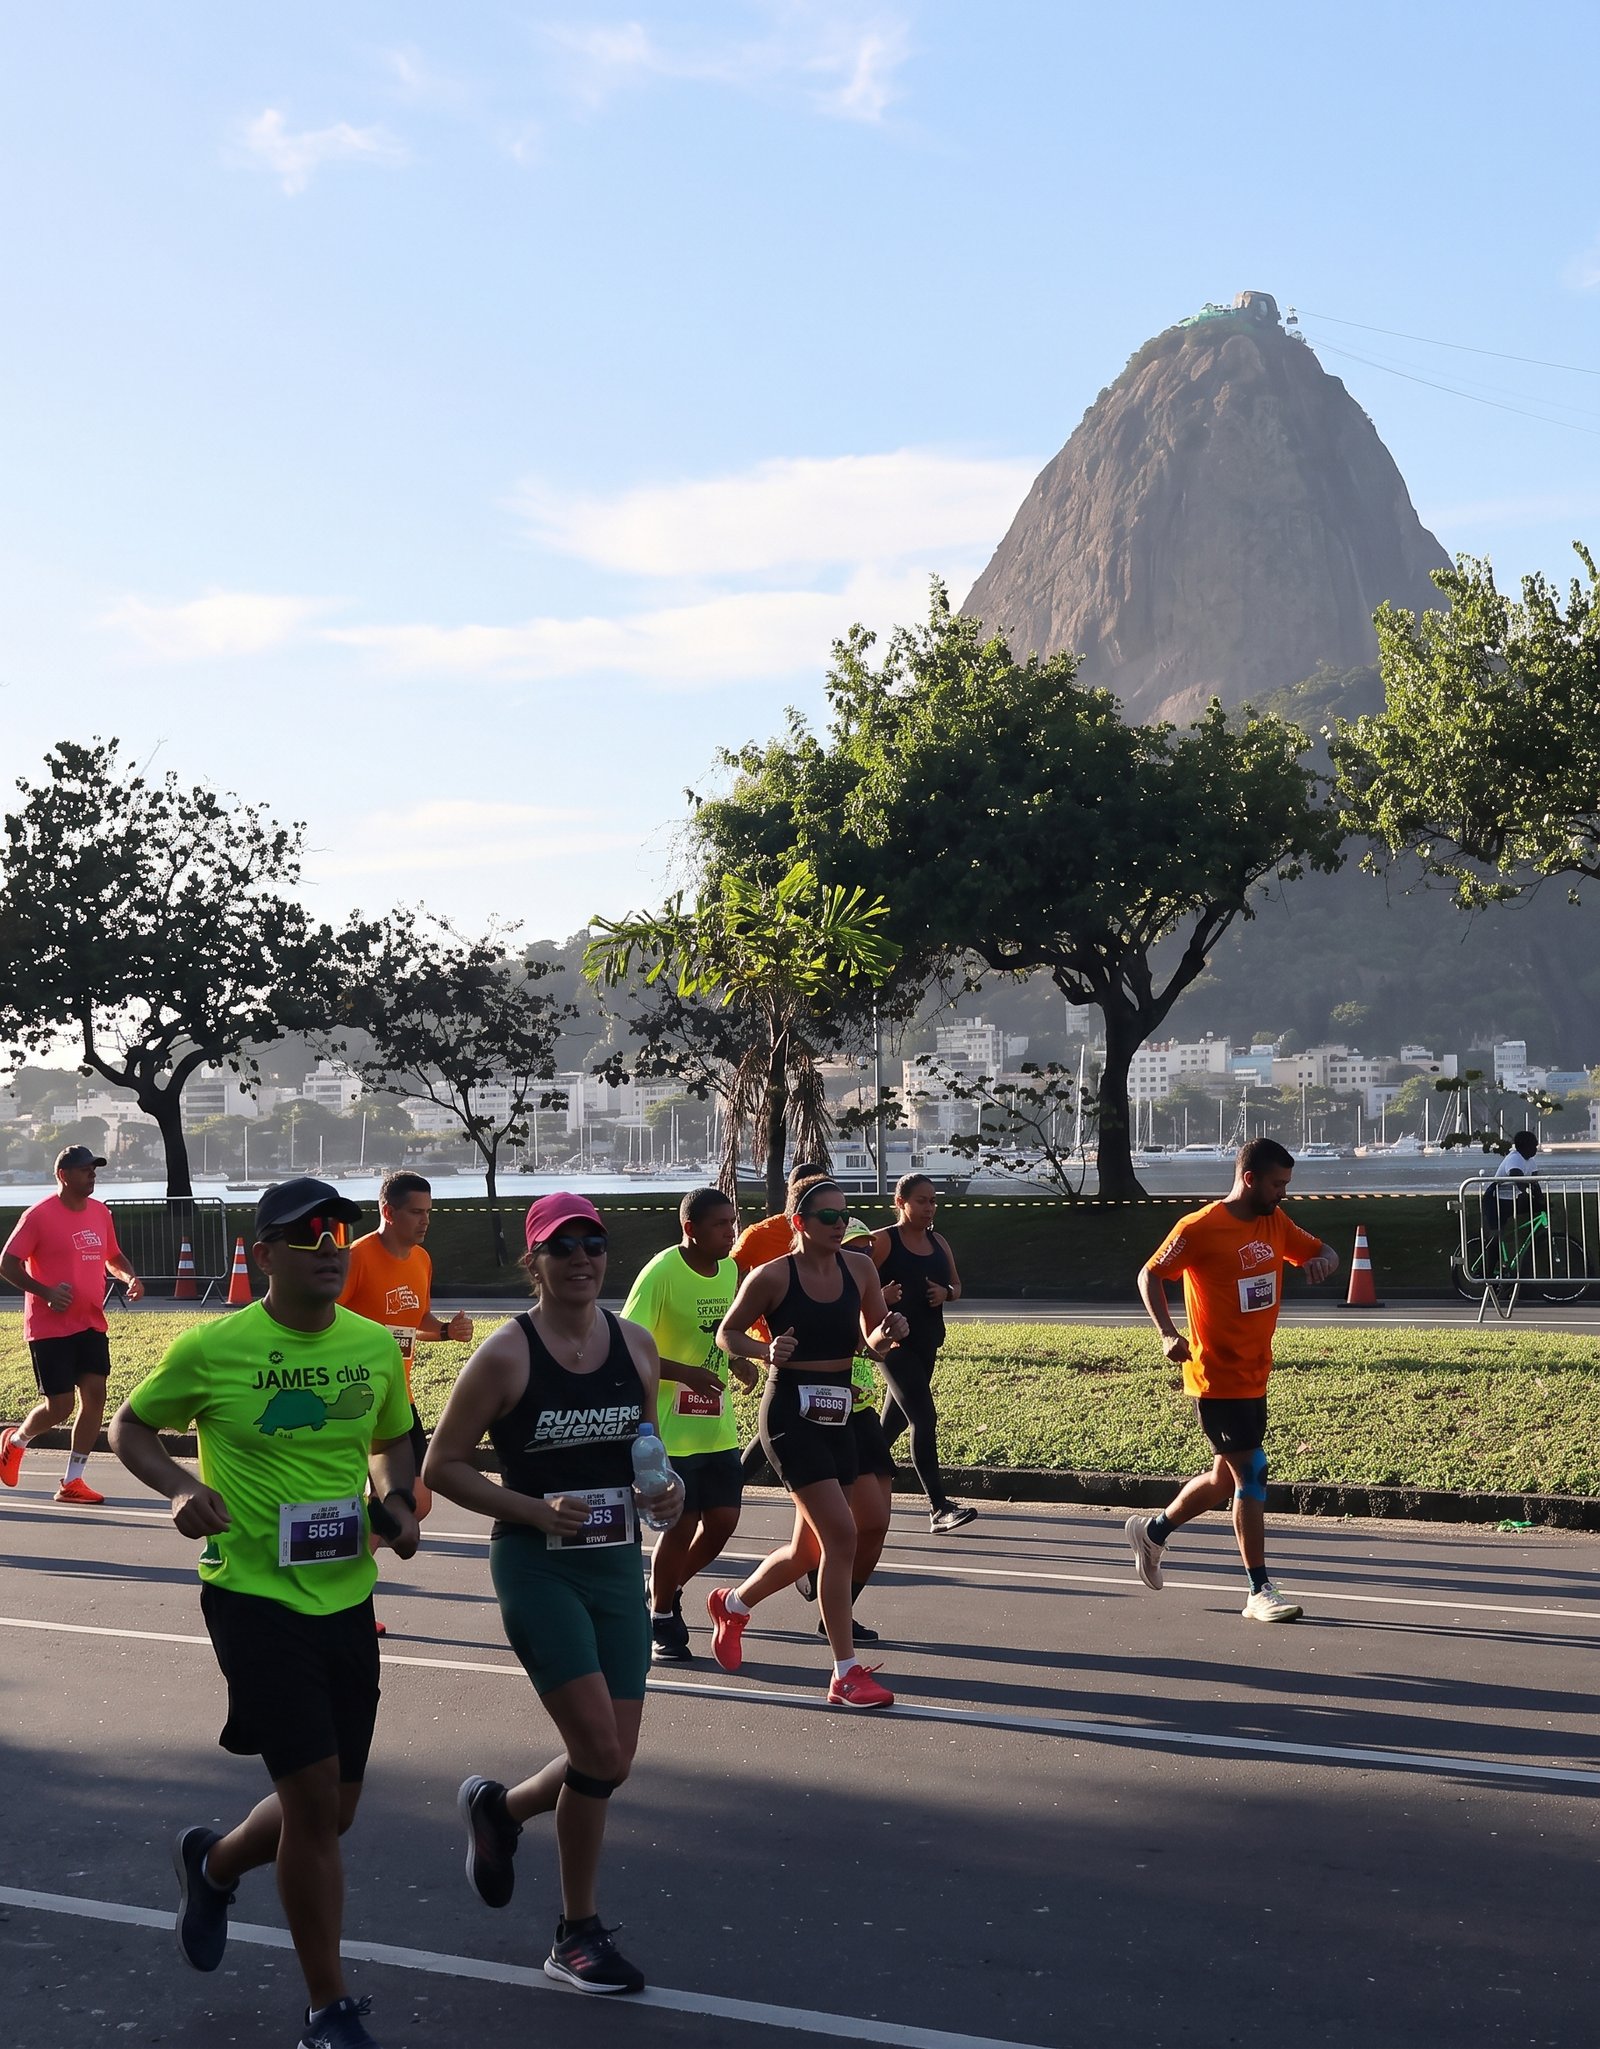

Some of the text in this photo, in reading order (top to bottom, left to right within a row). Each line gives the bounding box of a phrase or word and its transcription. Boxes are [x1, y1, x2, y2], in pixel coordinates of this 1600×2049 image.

[252, 1364, 370, 1389] JAMES club
[308, 1521, 345, 1540] 5651
